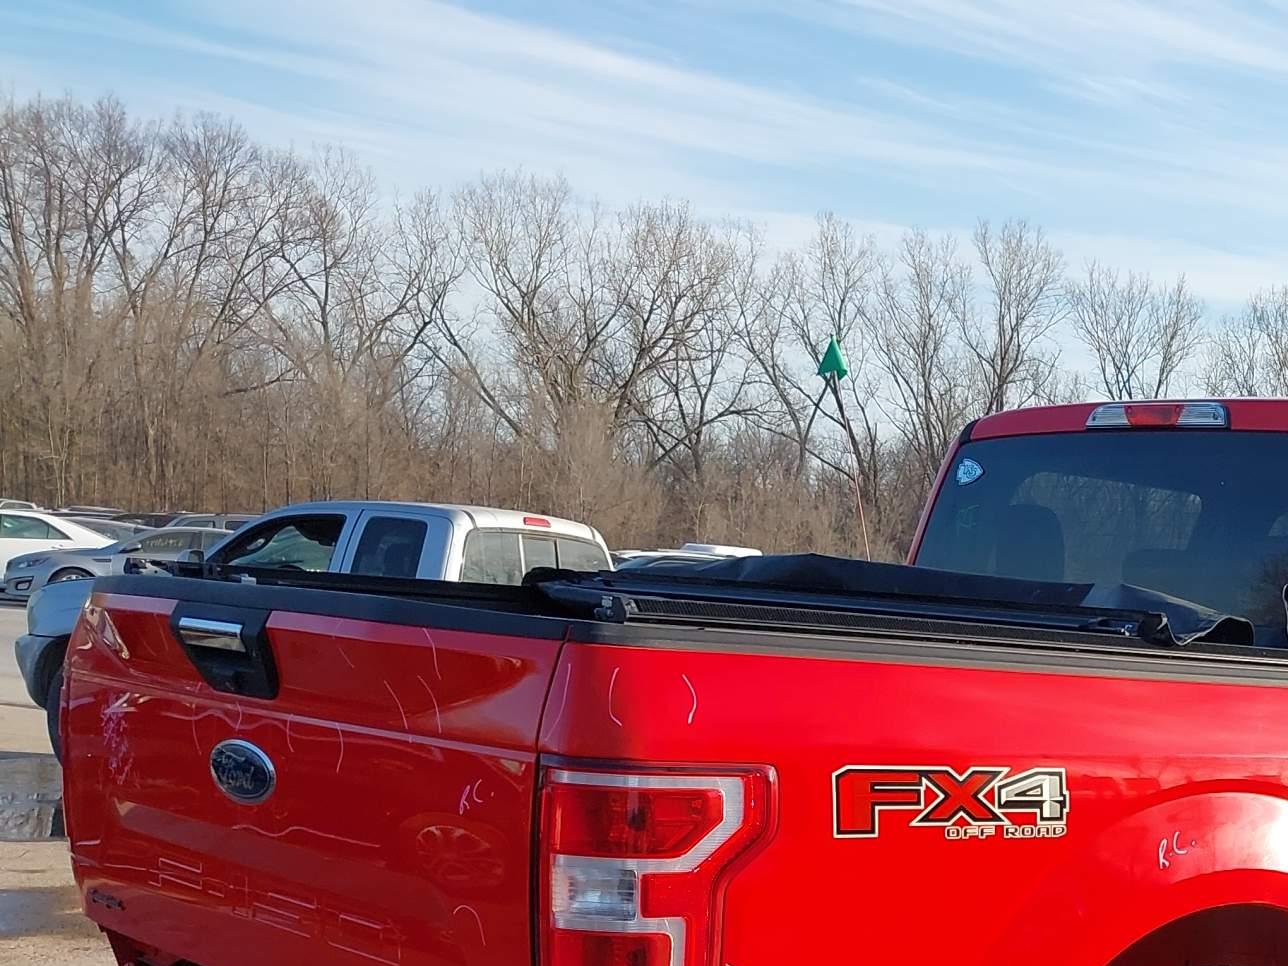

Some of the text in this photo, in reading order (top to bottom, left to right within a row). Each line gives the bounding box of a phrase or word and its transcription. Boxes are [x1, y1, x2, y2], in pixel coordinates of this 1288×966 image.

[832, 764, 1069, 839] FX4
[945, 824, 1067, 839] OFF ROAD
